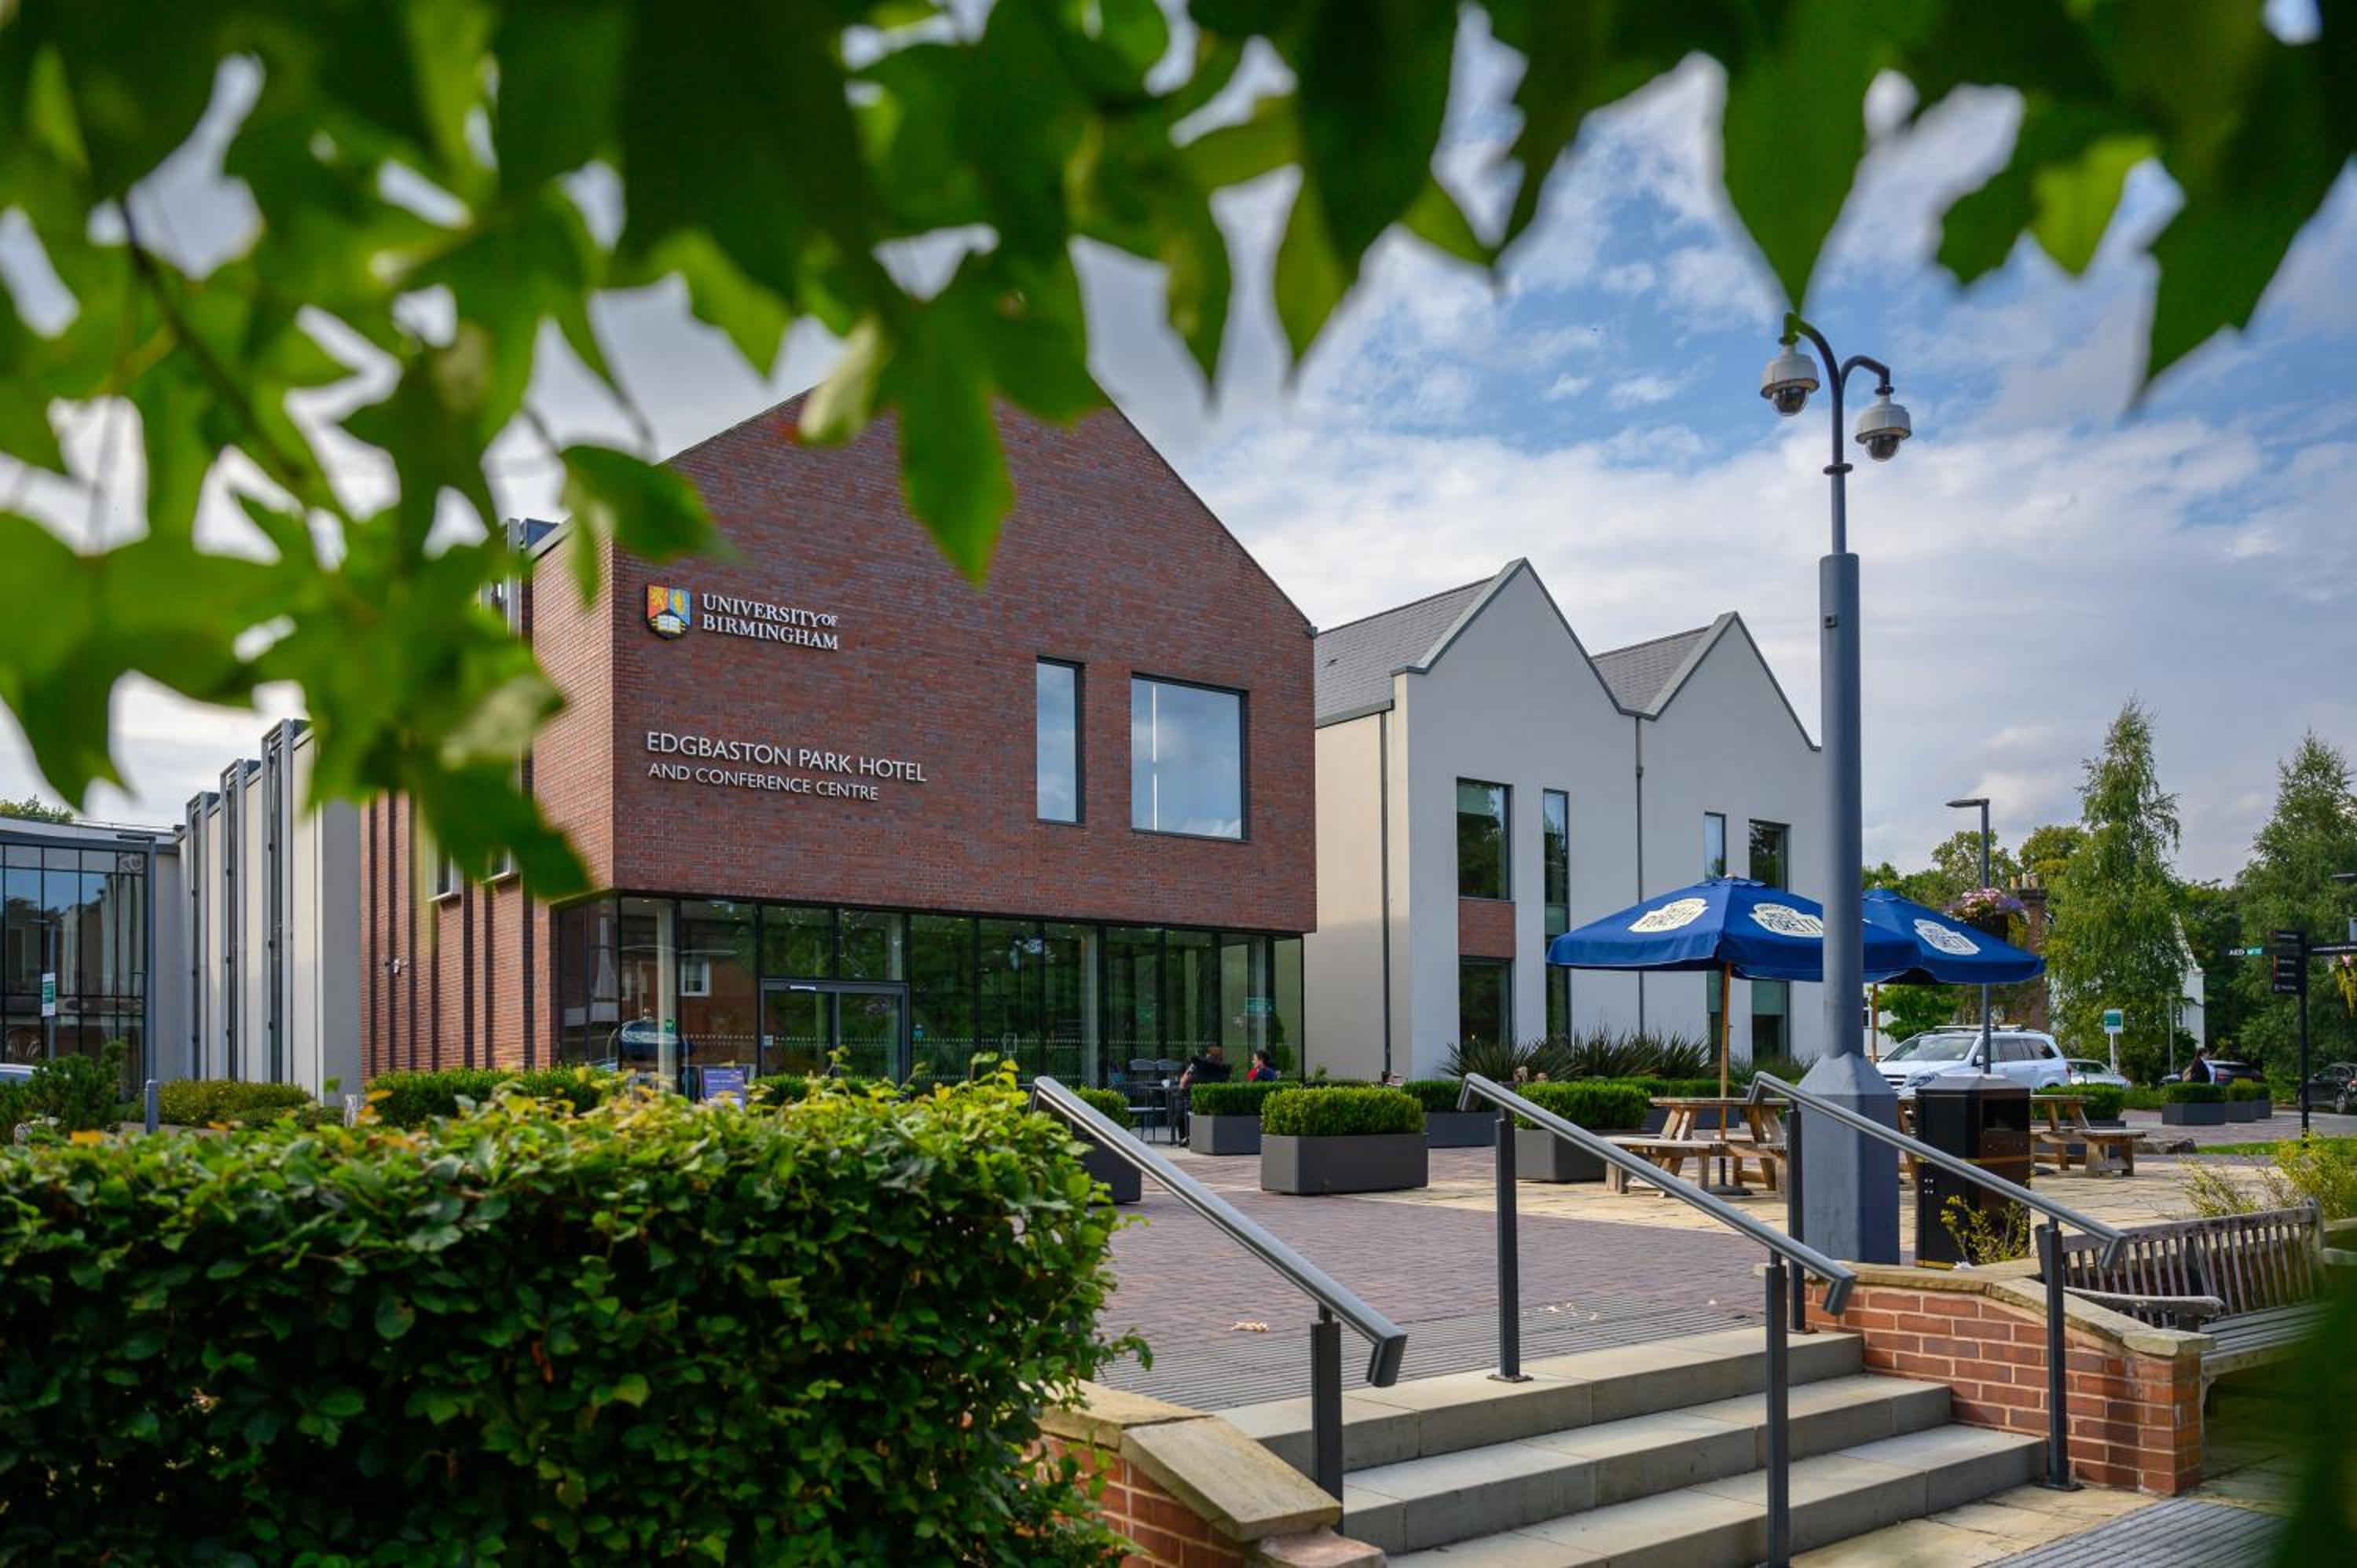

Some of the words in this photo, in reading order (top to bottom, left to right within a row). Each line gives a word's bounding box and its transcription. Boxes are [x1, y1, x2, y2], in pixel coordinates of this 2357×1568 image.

[702, 593, 820, 628] UNIVERSITY
[819, 614, 838, 627] OF
[702, 614, 838, 650] BIRMINGHAM
[647, 731, 791, 767] EDGBASTON
[799, 749, 852, 774] PARK
[860, 757, 927, 782] HOTEL
[647, 763, 691, 780] AND
[696, 768, 812, 793] CONFERENCE
[816, 781, 878, 800] CENTRE
